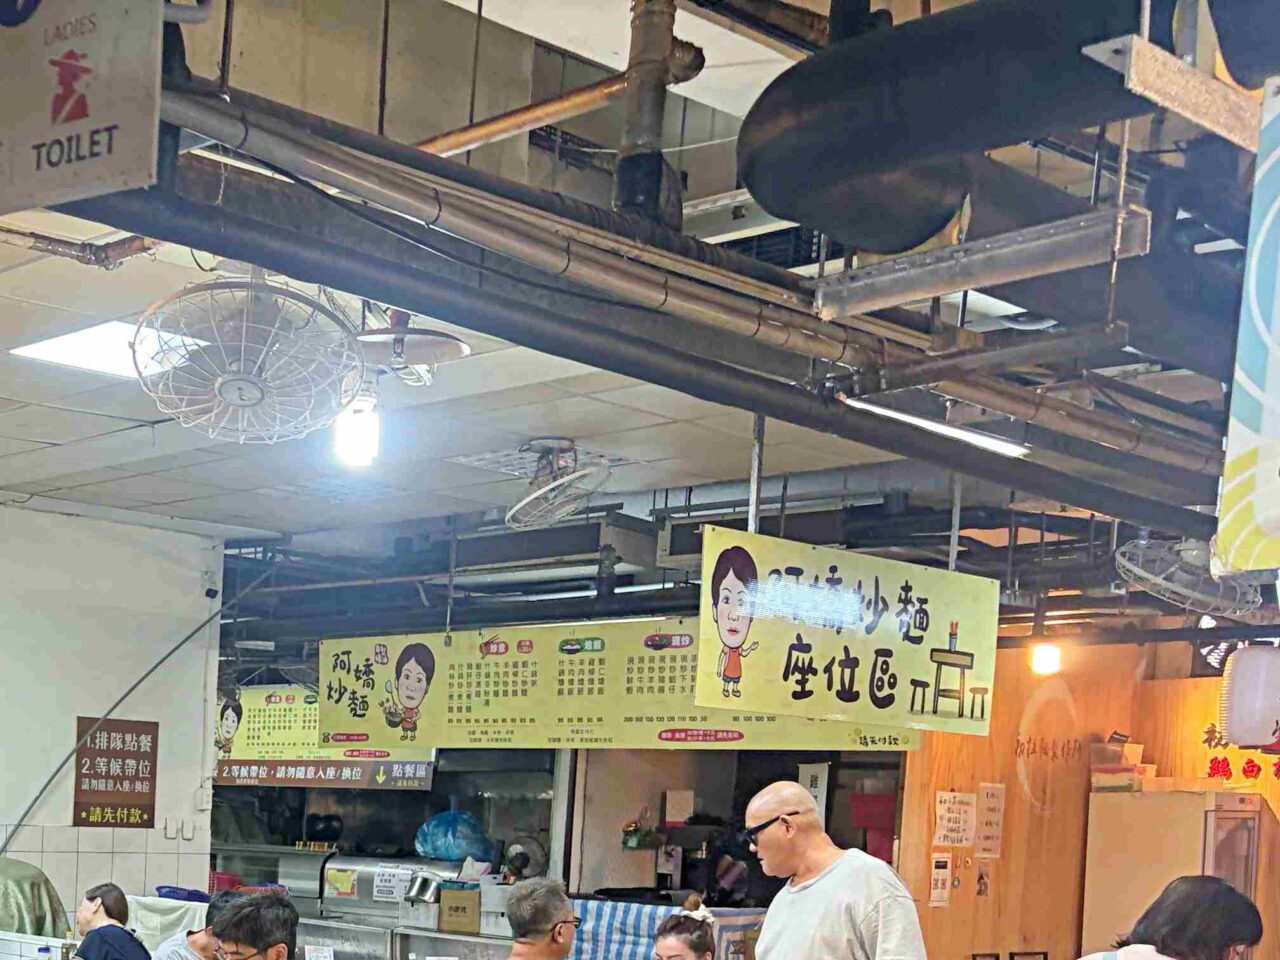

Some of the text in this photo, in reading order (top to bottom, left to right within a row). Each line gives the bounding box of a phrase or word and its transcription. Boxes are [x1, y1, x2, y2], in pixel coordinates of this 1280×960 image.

[32, 124, 119, 171] TOILET
[332, 650, 376, 690] 阿嬌
[782, 633, 898, 709] 座位區
[326, 677, 370, 718] 炒麵
[86, 731, 153, 752] 1.排隊點餐
[859, 735, 900, 747] 請先付款
[81, 757, 152, 778] 2.等候帶位
[392, 763, 427, 779] 點餐區
[89, 806, 142, 824] 請先付款
